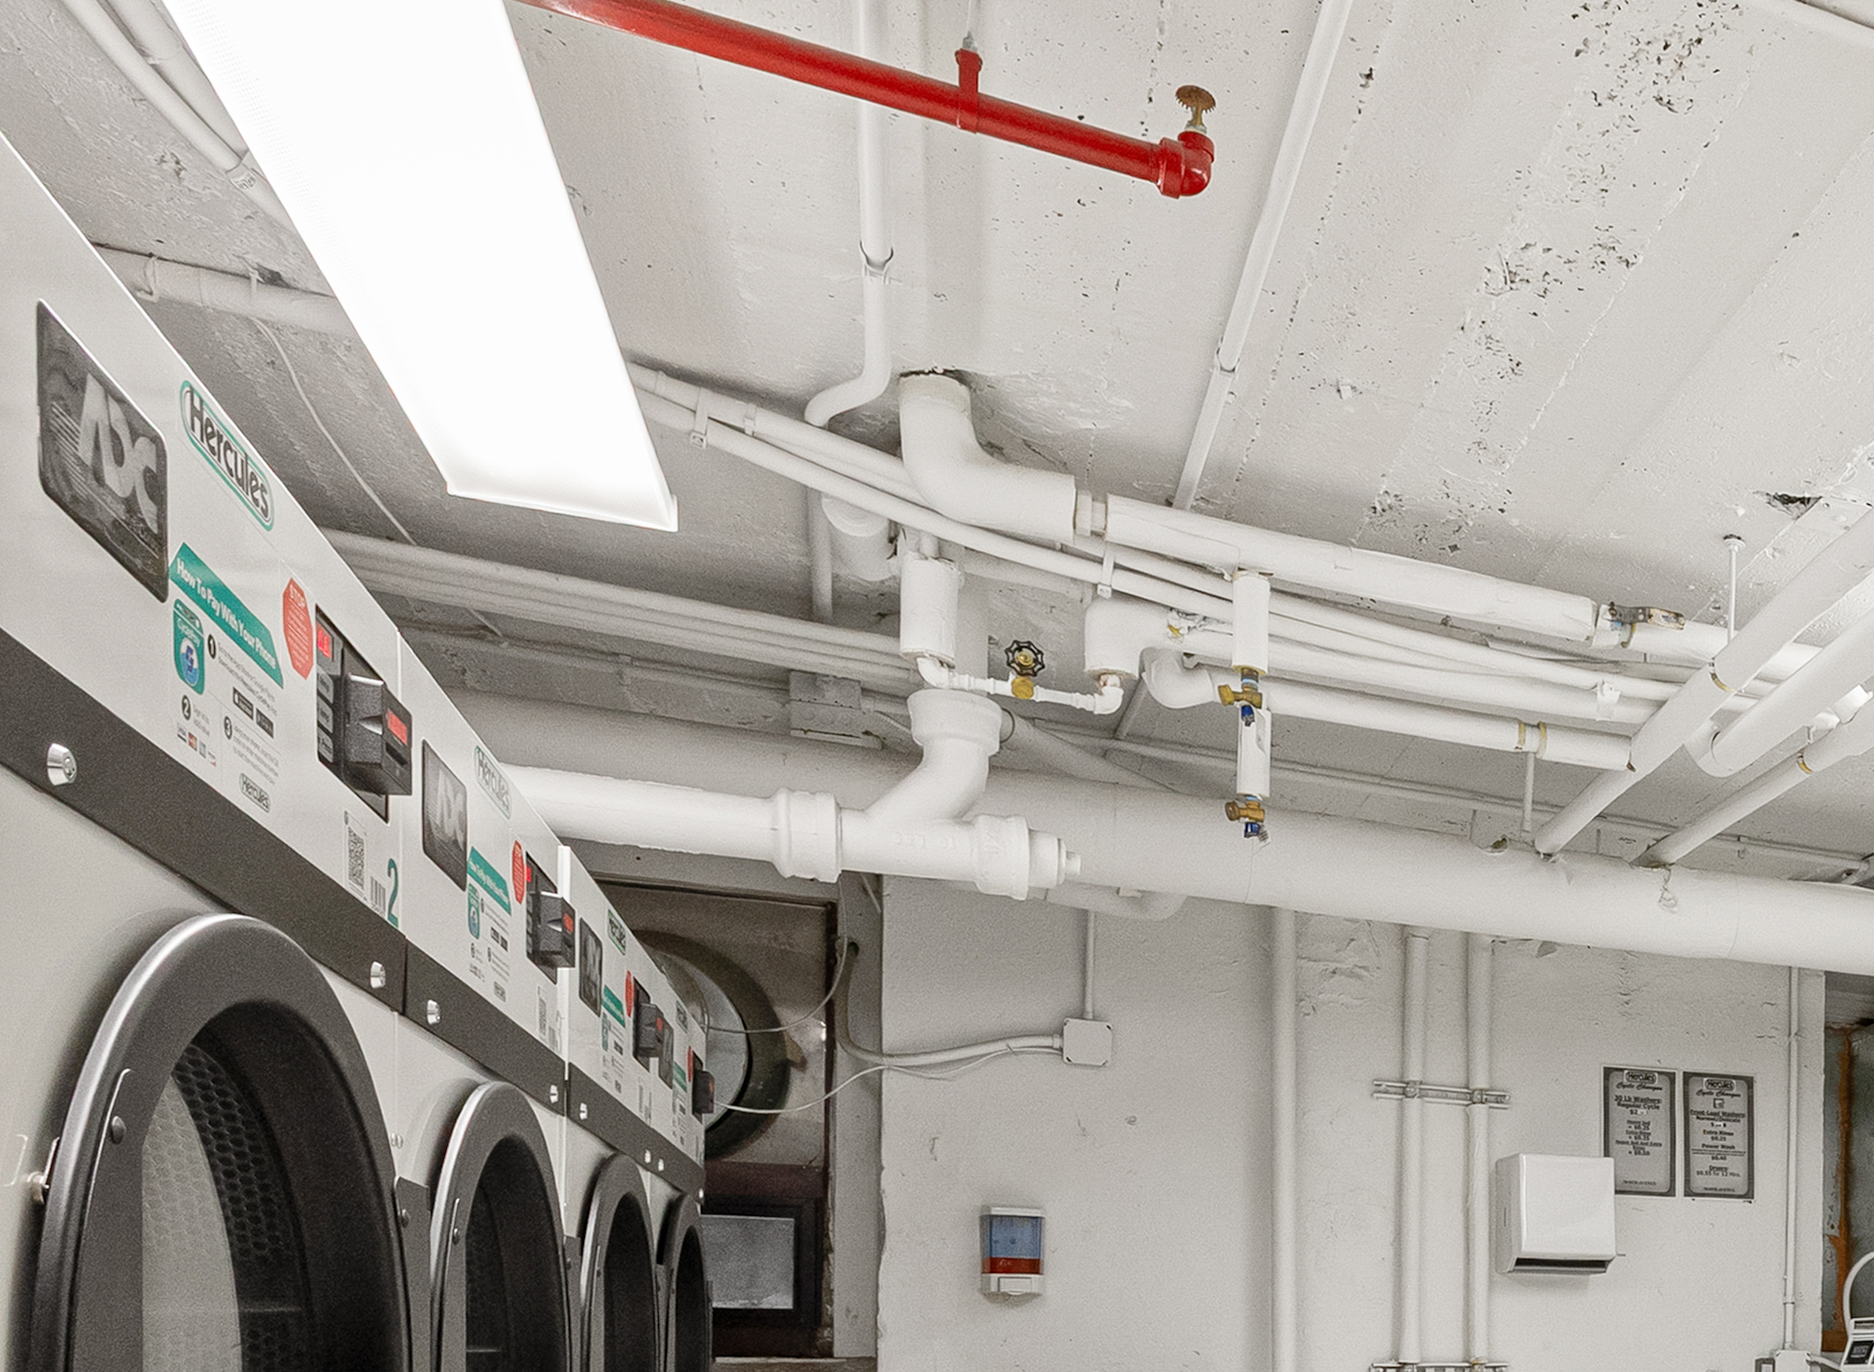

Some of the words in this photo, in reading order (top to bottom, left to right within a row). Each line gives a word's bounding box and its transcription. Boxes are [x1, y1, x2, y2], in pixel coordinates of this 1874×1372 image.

[189, 385, 269, 519] Hercules
[177, 557, 196, 589] How
[196, 577, 207, 600] To
[206, 588, 221, 617] Pay
[220, 601, 239, 633] With
[237, 619, 256, 648] Your
[255, 636, 277, 670] Phone
[387, 858, 399, 928] 2
